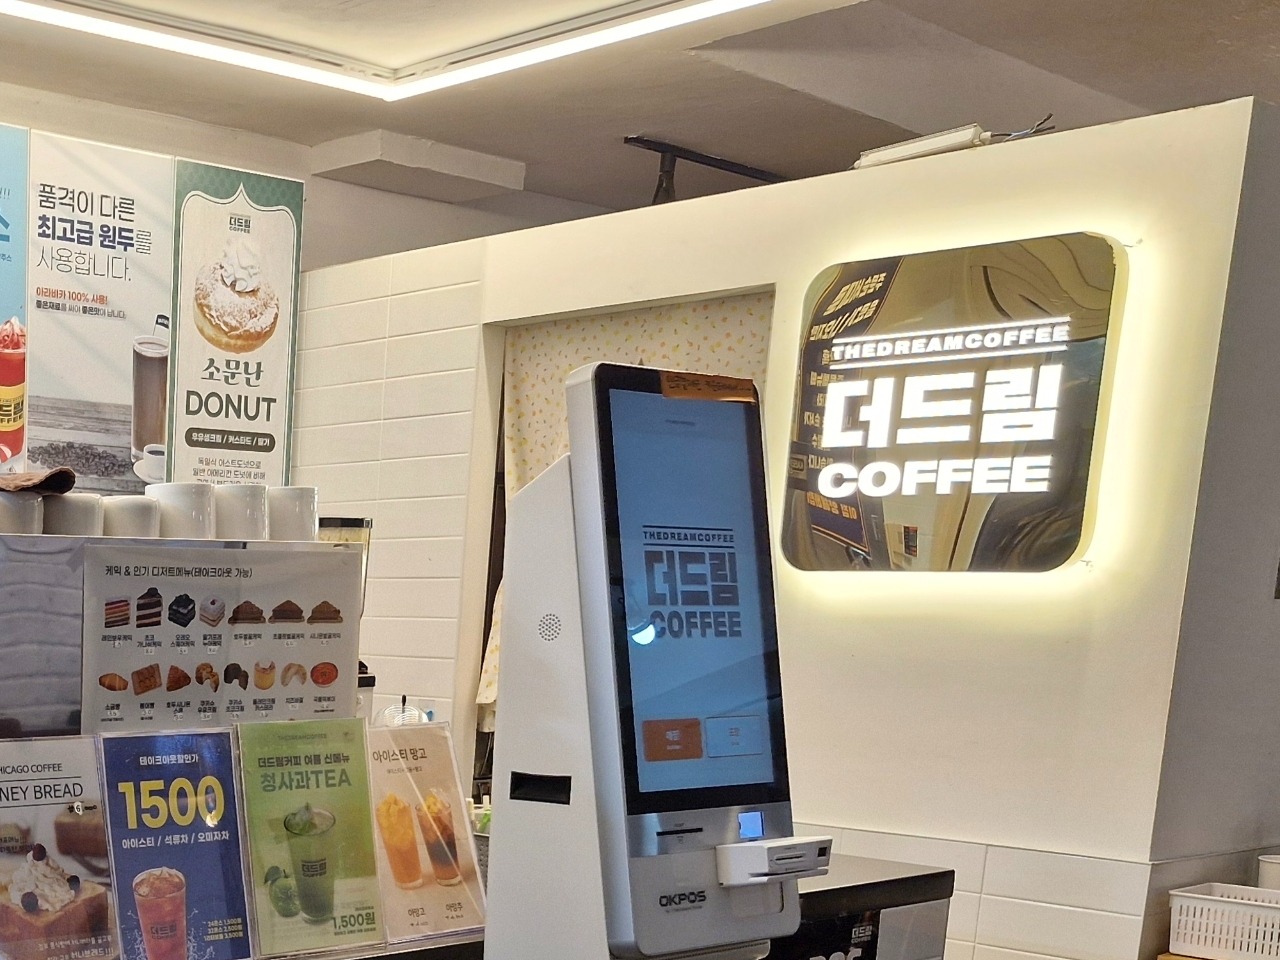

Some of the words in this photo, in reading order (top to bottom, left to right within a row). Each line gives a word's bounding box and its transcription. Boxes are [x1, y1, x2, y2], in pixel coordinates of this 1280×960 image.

[39, 184, 93, 216] 품격이
[101, 195, 135, 222] 다른
[38, 214, 94, 246] 최고급
[99, 224, 152, 254] 원두를
[37, 246, 131, 281] 사용합니다.
[36, 287, 66, 299] 아라비카
[68, 291, 89, 302] 100%
[91, 294, 108, 305] 사용!
[832, 324, 1069, 360] THEDREAMCOFFEE
[201, 358, 264, 387] 소문난
[186, 390, 276, 421] DONUT
[823, 364, 1063, 447] 더드림
[818, 455, 1052, 497] COFFEE
[643, 530, 735, 543] THEDREAMCOFFEE
[105, 566, 121, 576] 케익
[124, 566, 130, 576] &
[134, 566, 149, 576] 인기
[152, 566, 232, 577] 디저트메뉴(테이크아웃
[235, 568, 252, 578] 가능)
[644, 550, 740, 606] 더드림
[649, 610, 742, 638] COFFEE
[140, 754, 198, 766] 테이크아웃할인가
[258, 756, 301, 768] 더드림커피
[304, 754, 321, 766] 여름
[325, 753, 350, 764] 신메뉴
[373, 750, 408, 763] 아이스티
[410, 748, 427, 760] 망고
[30, 764, 62, 773] COFFEE
[34, 782, 83, 799] BREAD
[261, 769, 352, 793] 청사과TEA
[118, 776, 224, 830] 1500
[122, 837, 154, 849] 아이스티
[164, 834, 188, 845] 석류차
[198, 831, 229, 843] 오미자차
[659, 891, 706, 908] OKPOS
[332, 912, 375, 929] 1,500원
